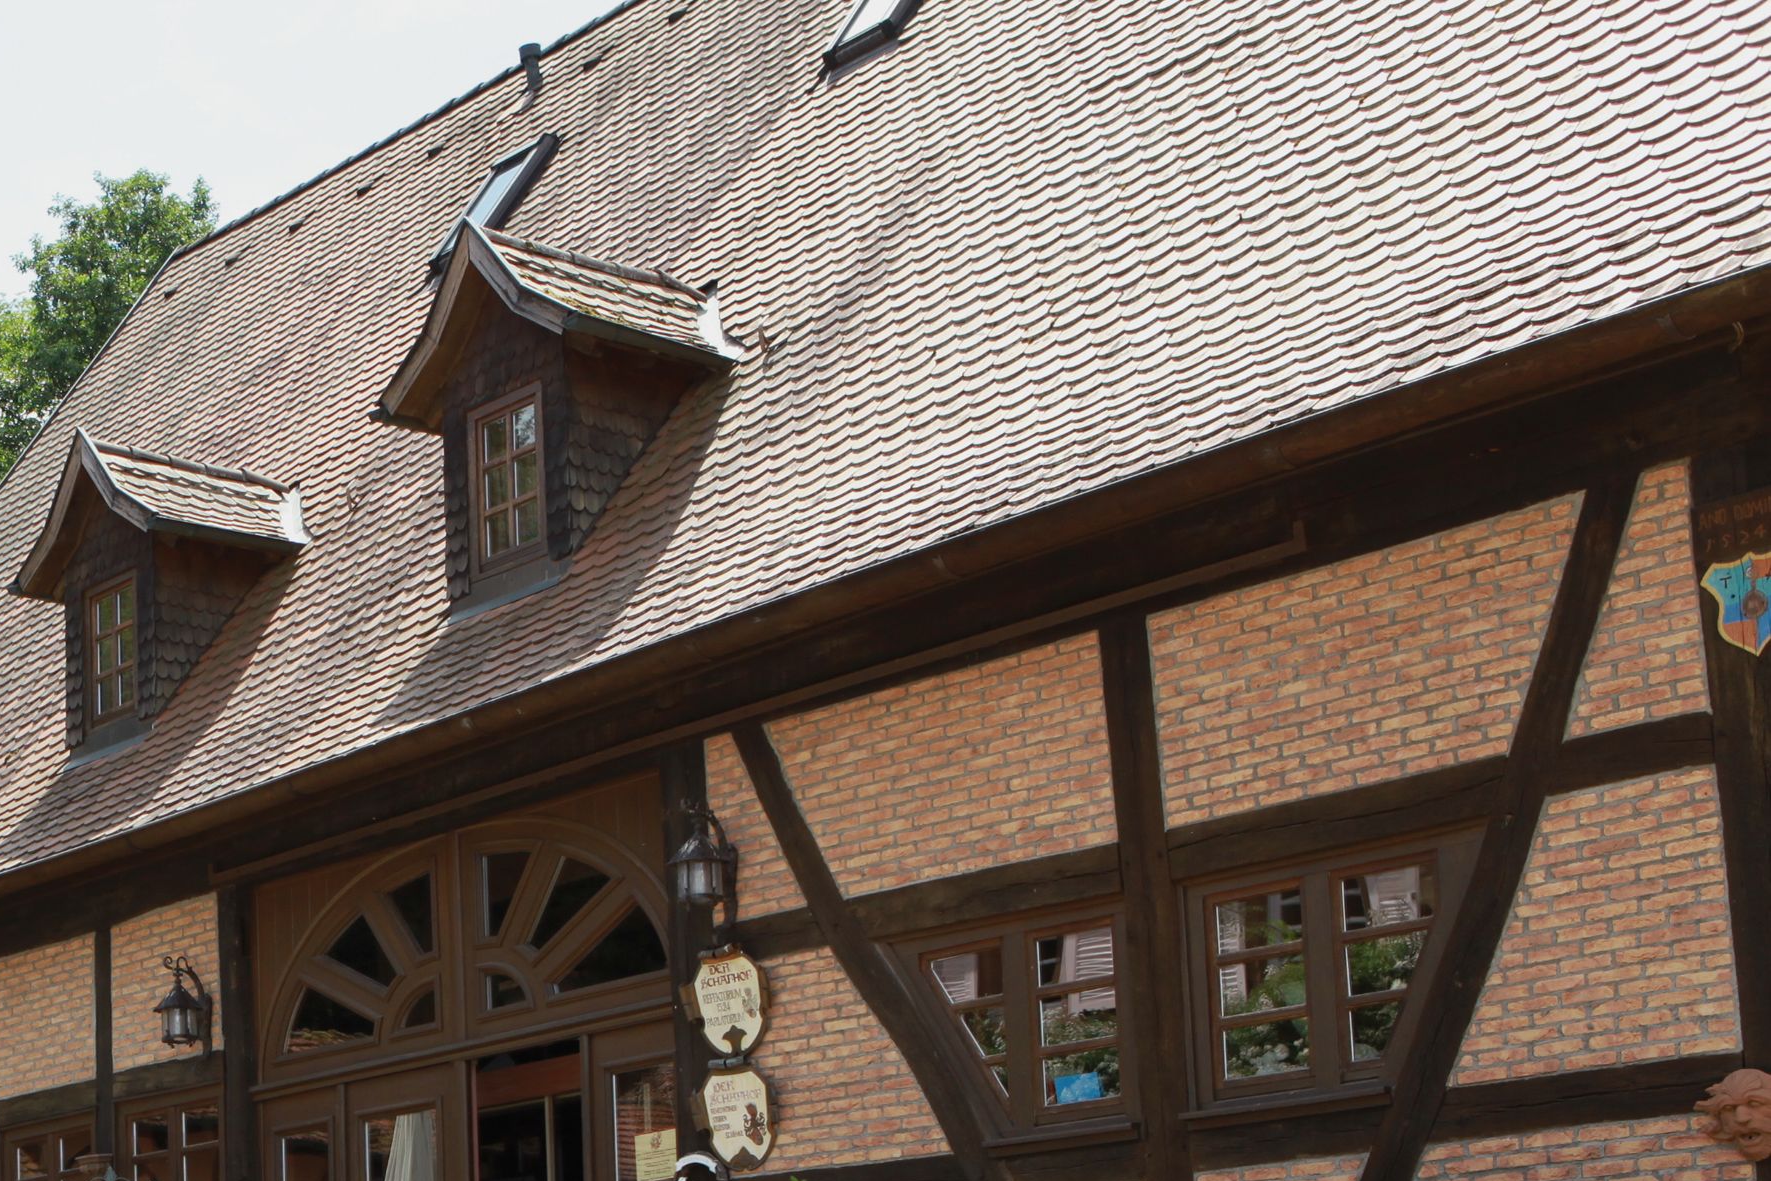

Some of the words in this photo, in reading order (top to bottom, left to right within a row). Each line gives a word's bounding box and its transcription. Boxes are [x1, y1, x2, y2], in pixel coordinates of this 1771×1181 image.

[708, 962, 730, 975] DER
[700, 969, 753, 990] SCHAFHOF
[713, 1080, 735, 1093] DER
[709, 1088, 762, 1107] SCHAFHOF
